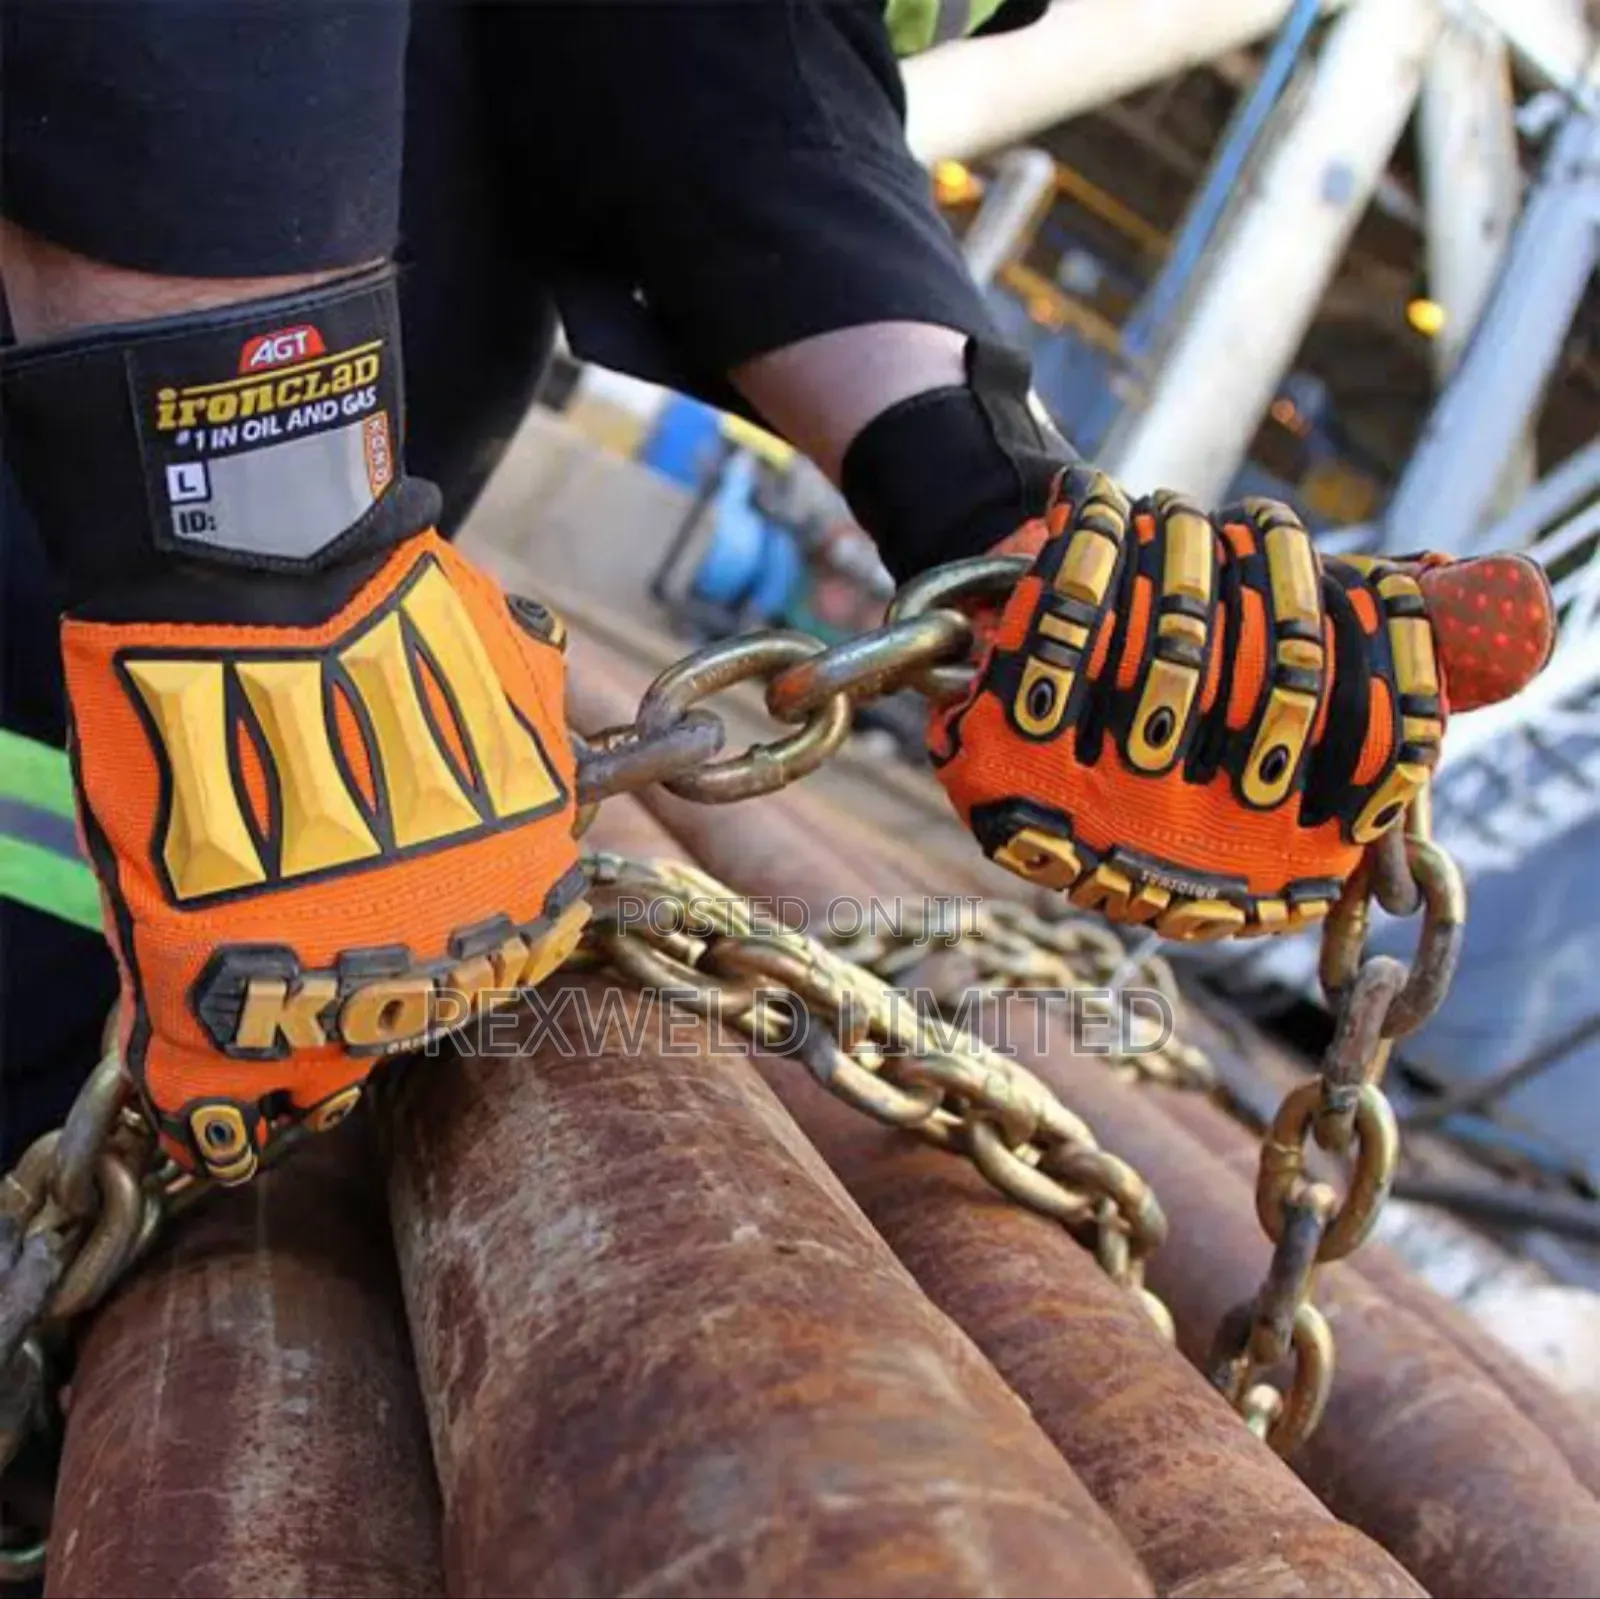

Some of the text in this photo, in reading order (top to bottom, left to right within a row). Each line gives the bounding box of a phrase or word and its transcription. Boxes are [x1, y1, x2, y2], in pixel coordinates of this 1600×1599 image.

[250, 330, 309, 366] AGT
[210, 425, 238, 449] IN
[242, 417, 283, 442] OIL
[286, 398, 338, 431] AND
[341, 385, 377, 416] GAS
[177, 470, 197, 494] L
[178, 510, 217, 534] ID:
